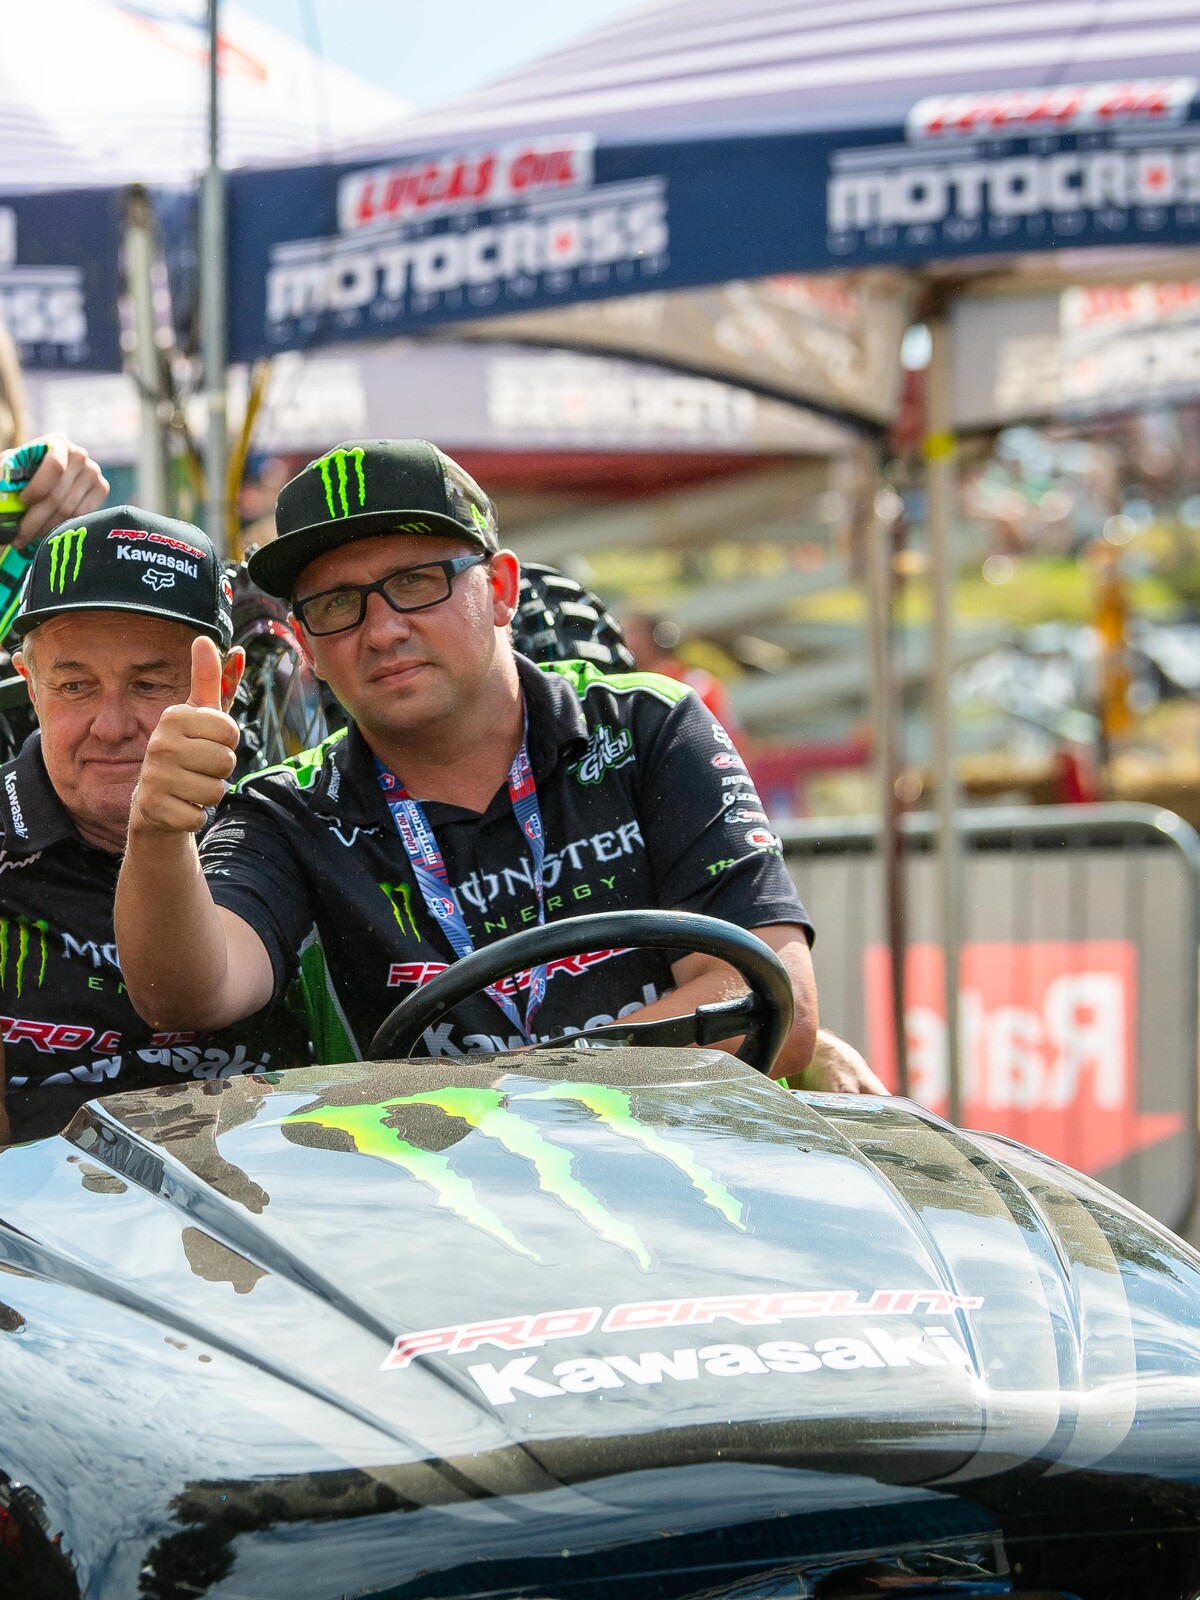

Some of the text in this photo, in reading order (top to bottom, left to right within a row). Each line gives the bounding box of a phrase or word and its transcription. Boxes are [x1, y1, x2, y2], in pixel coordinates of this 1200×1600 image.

[353, 144, 578, 224] LUCAS OIL
[827, 153, 1200, 231] MOTOCRO
[266, 200, 669, 326] MOTOCROSS
[107, 529, 147, 541] PRO
[116, 545, 198, 580] Kawasaki
[4, 770, 29, 840] Kawasaki
[381, 1289, 985, 1369] PRO CIRCUIT
[467, 1326, 982, 1407] Kawasaki
